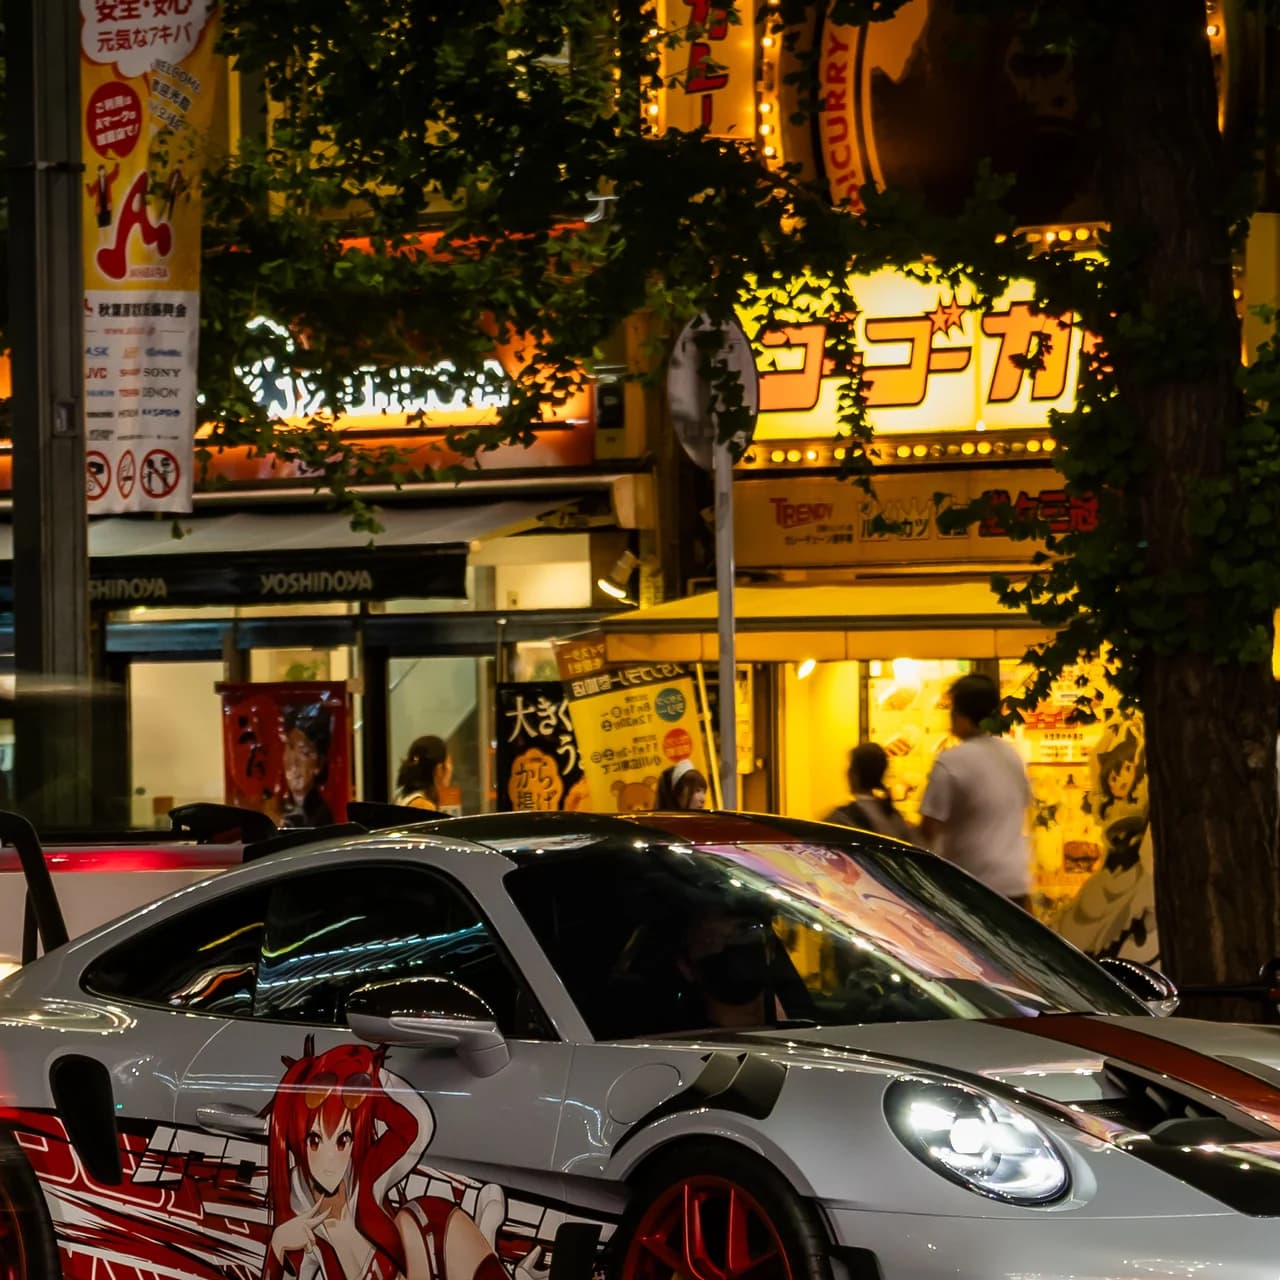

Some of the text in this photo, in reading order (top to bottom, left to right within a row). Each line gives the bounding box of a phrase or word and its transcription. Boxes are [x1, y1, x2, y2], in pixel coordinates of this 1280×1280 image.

[96, 22, 193, 53] 元気なアキバ
[143, 367, 182, 378] SONY
[88, 576, 168, 598] SHINOYA
[260, 569, 373, 595] YOSHINOYA
